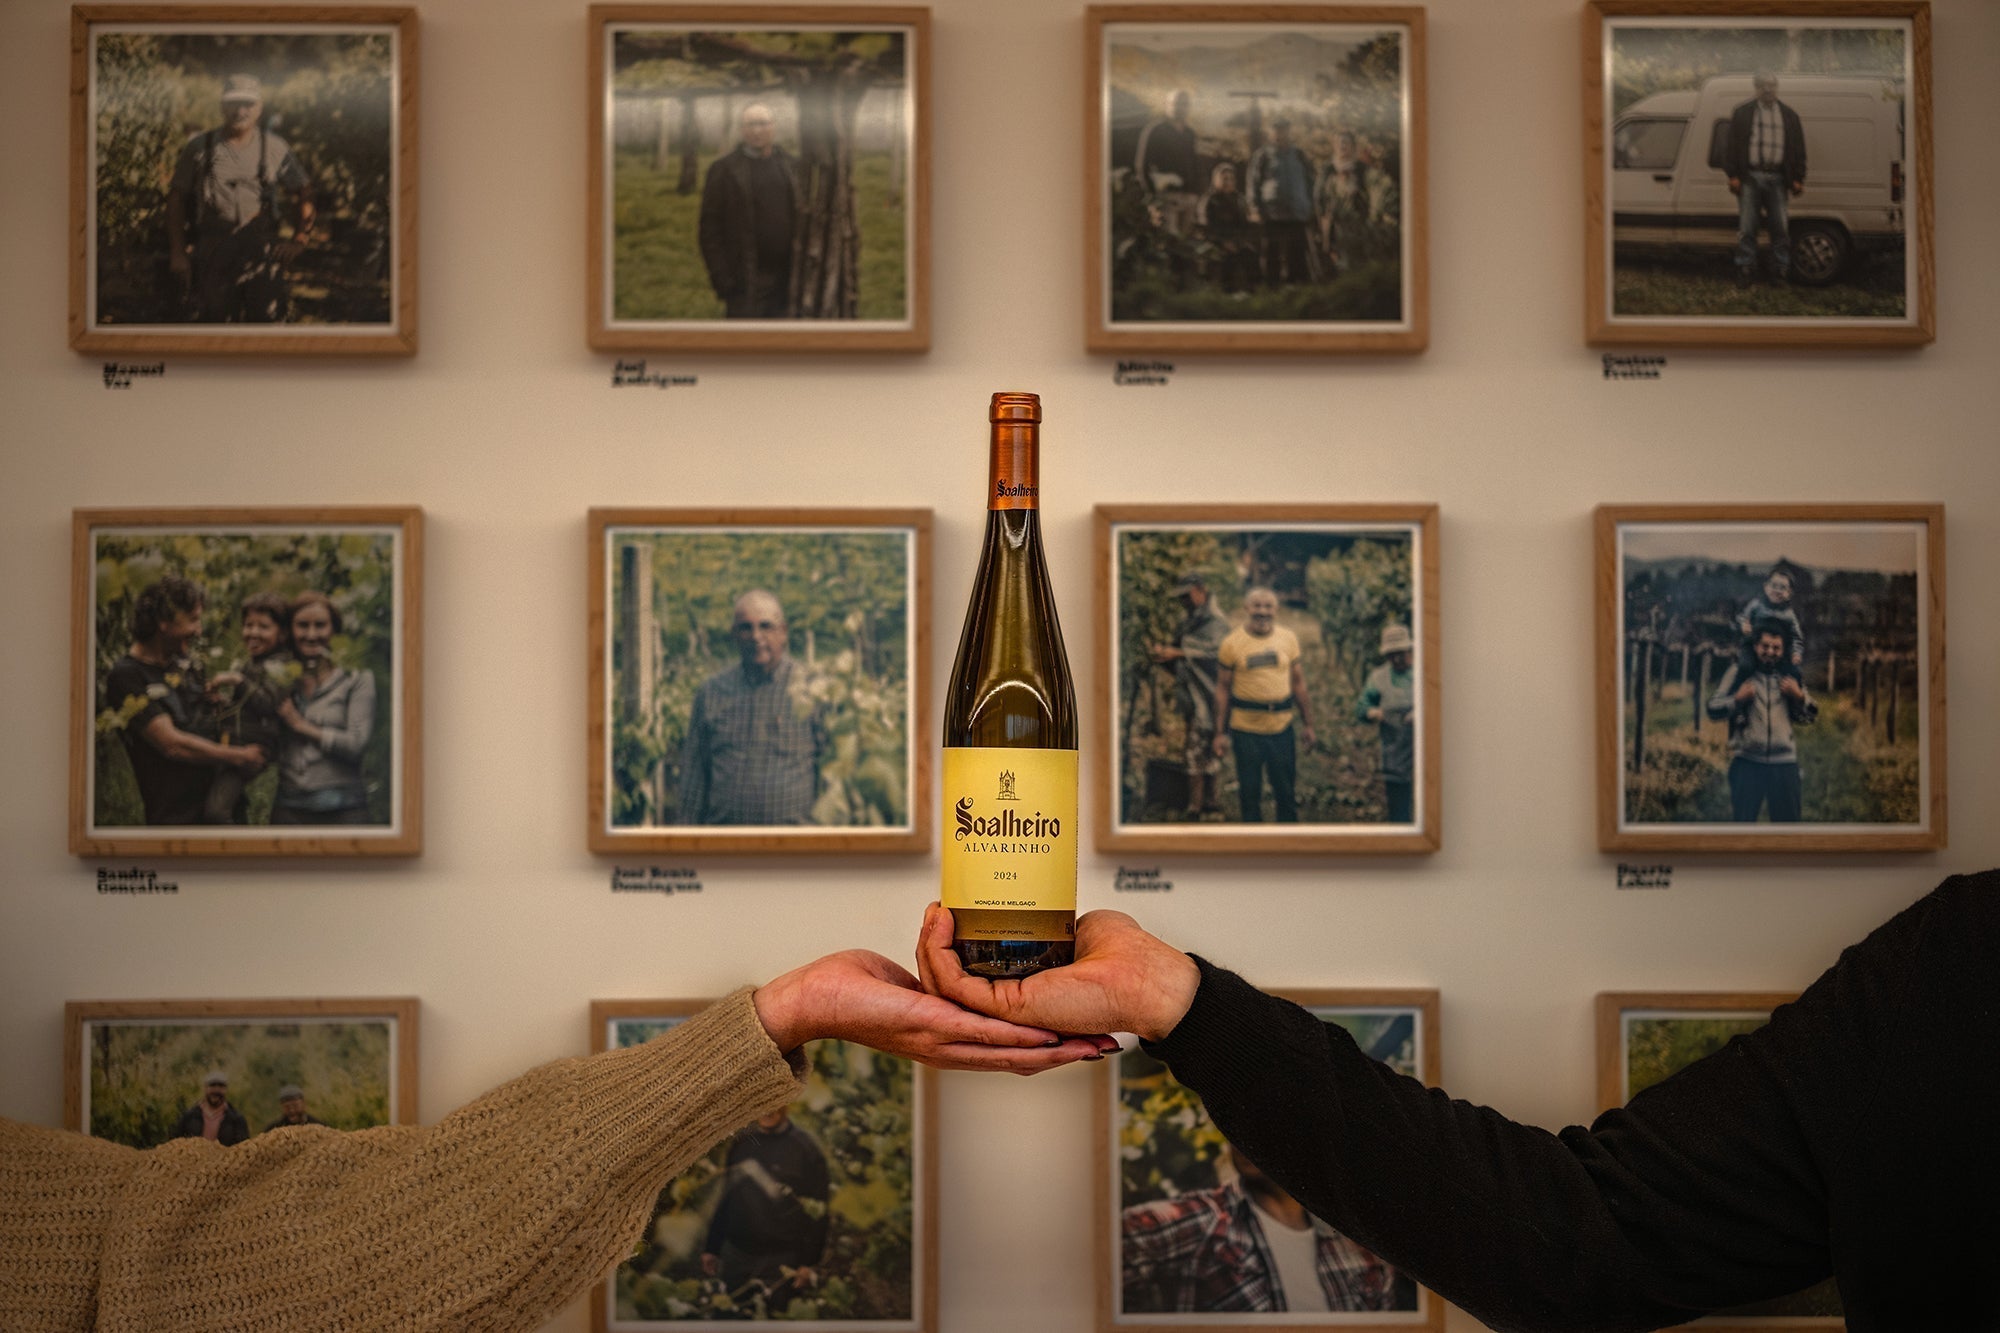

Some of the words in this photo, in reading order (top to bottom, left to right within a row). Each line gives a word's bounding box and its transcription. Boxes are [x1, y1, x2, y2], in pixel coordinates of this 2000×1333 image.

[996, 479, 1039, 498] Soalheiro
[955, 796, 1061, 842] Soalheiro
[964, 843, 1051, 854] ALVARINHO
[97, 867, 157, 880] Sandra
[993, 871, 1018, 881] 2024
